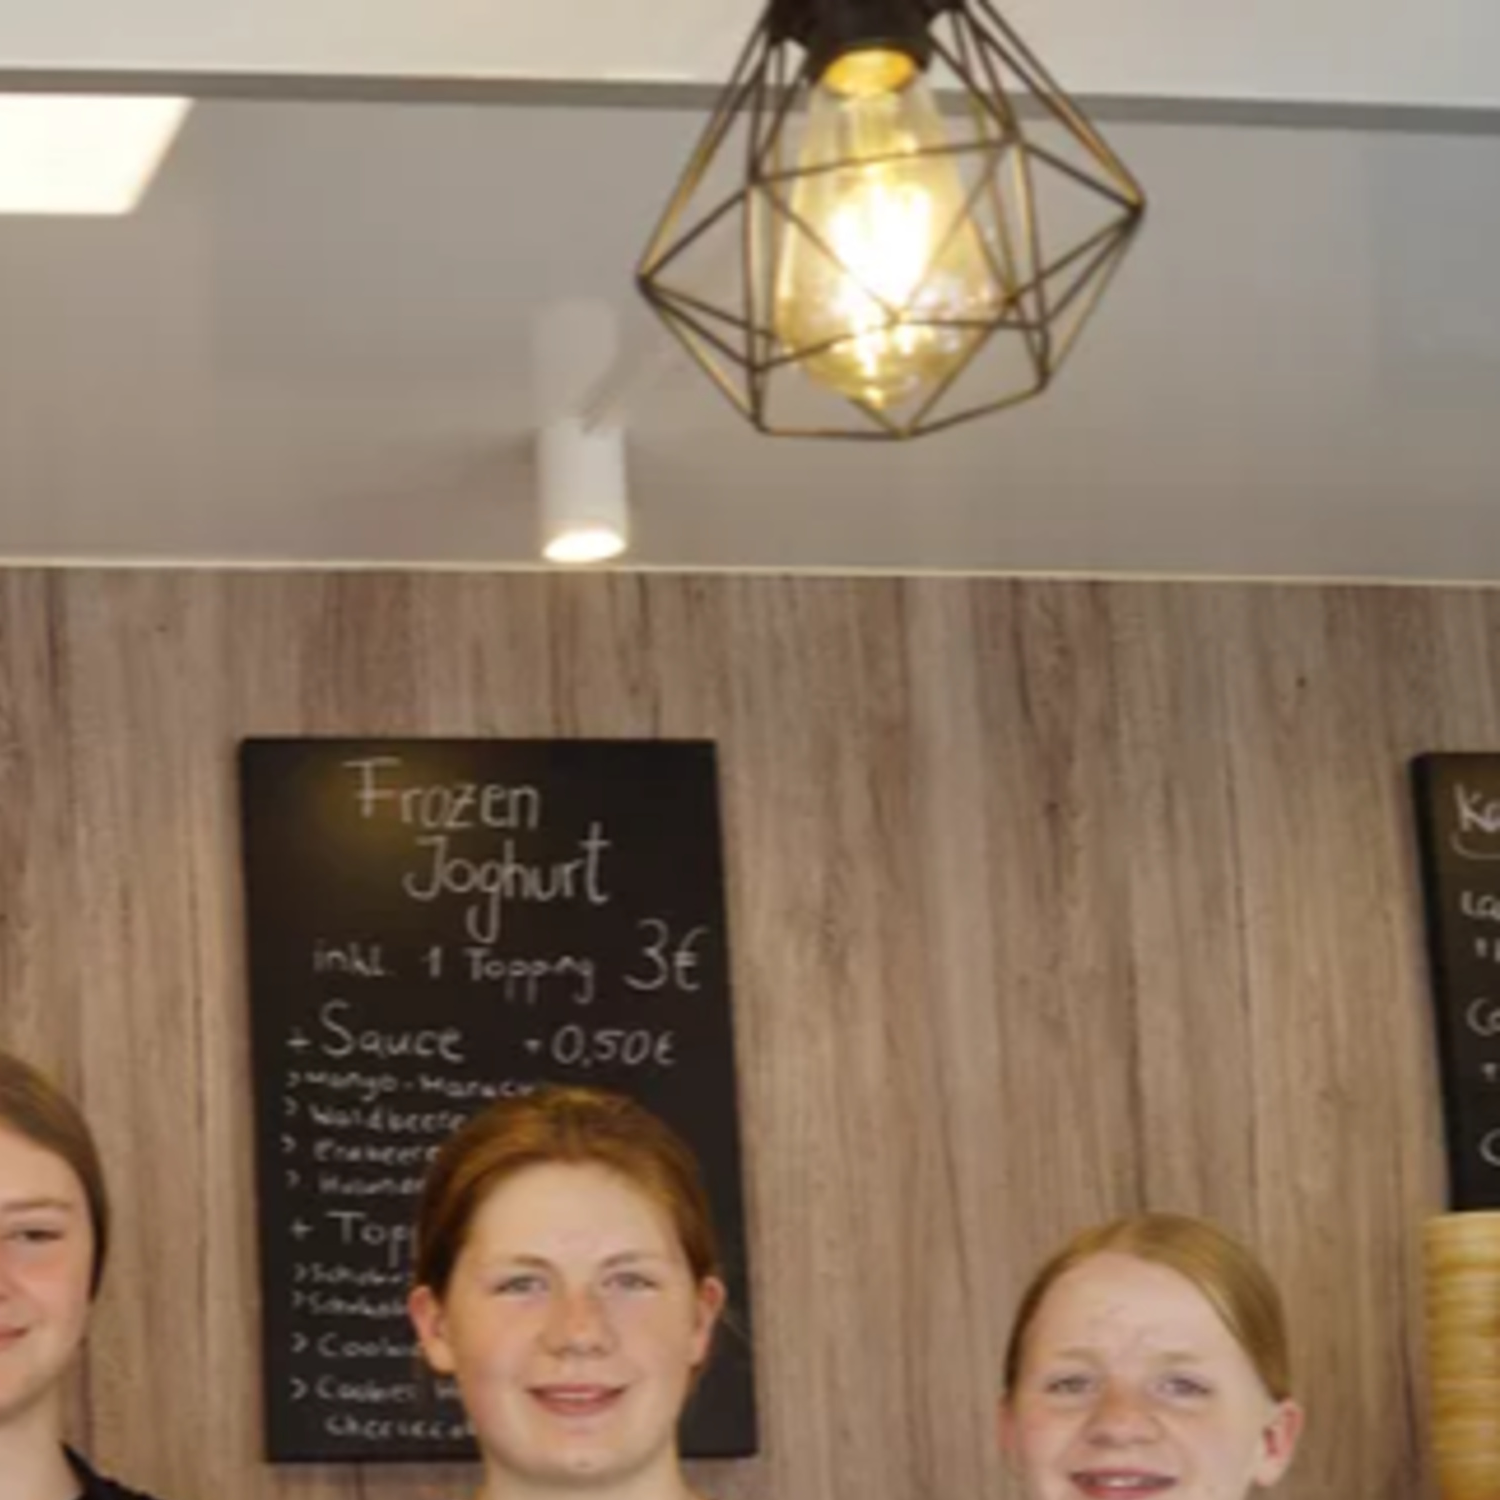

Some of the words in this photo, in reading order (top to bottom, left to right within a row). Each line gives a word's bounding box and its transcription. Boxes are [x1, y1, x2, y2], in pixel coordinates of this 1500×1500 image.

[343, 757, 540, 828] Frozen
[403, 822, 612, 943] Joghurt
[426, 947, 442, 978] 1
[624, 919, 708, 990] 3€
[320, 1000, 466, 1062] Sauce
